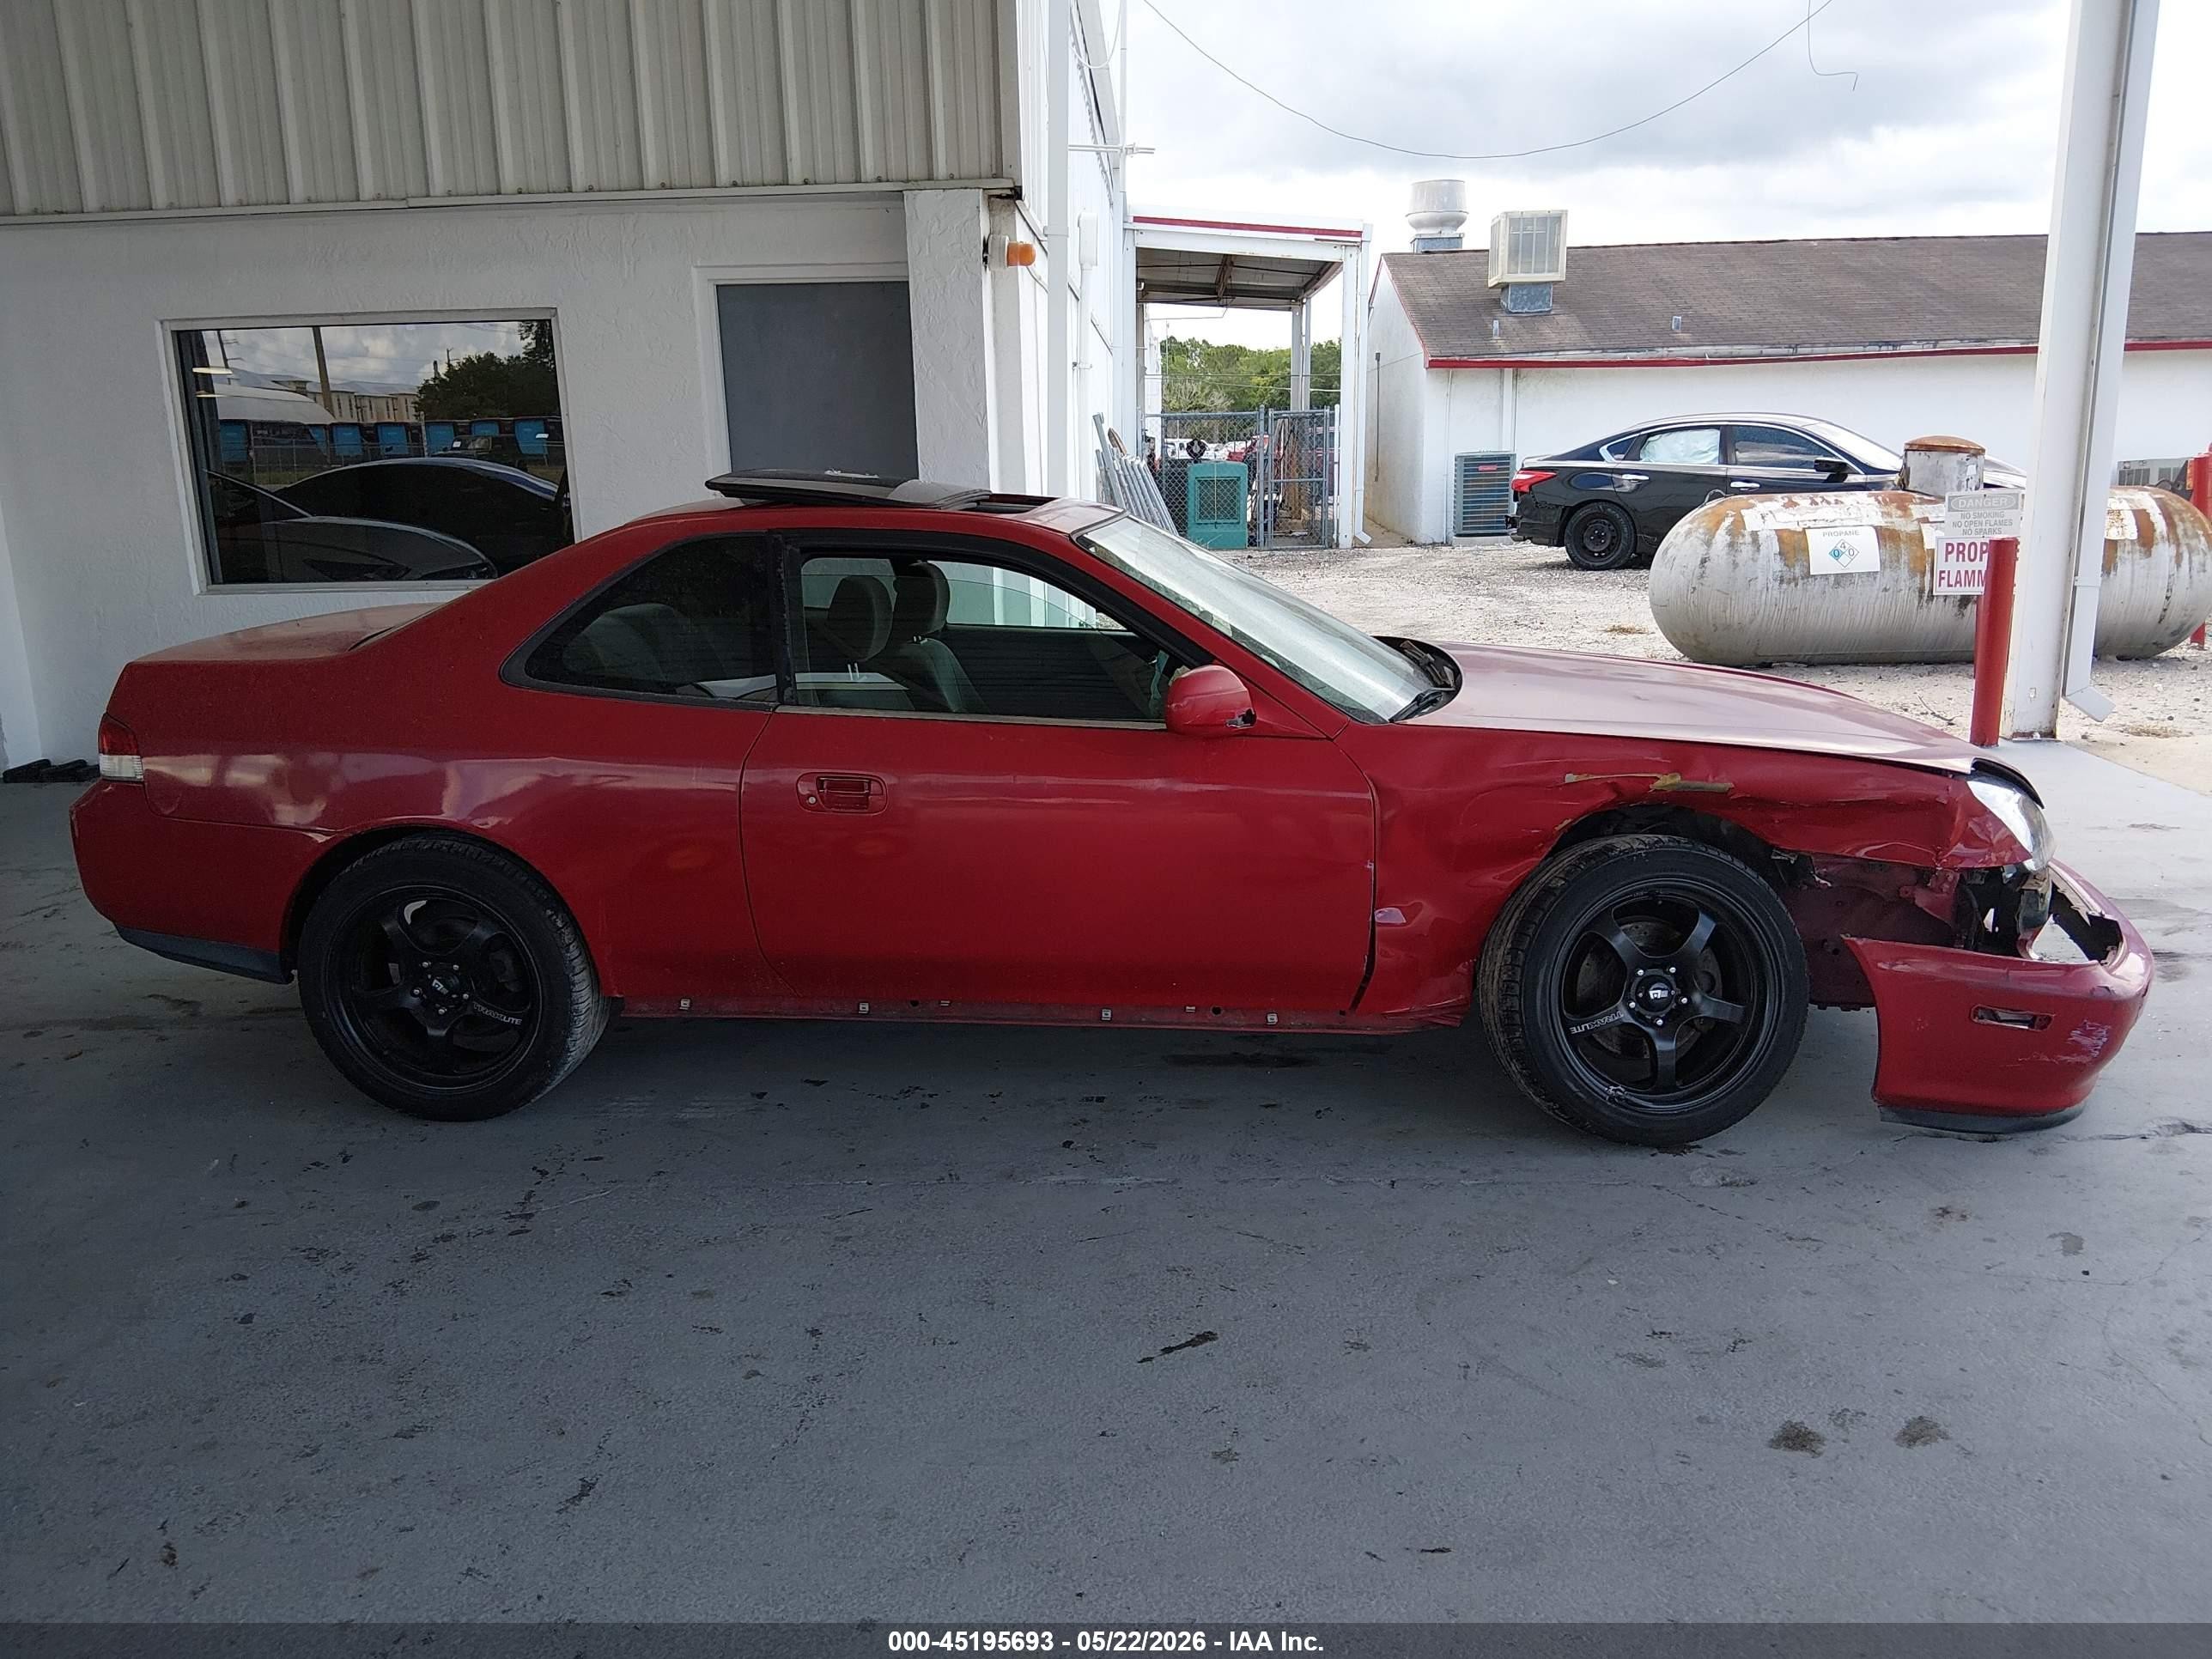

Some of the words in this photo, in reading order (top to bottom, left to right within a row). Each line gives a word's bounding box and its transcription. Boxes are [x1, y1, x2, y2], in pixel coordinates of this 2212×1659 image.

[1958, 497, 2008, 508] DANGER
[1972, 511, 2005, 520] SMOKING
[1952, 520, 1963, 529] NO
[1964, 520, 1984, 528] OPEN
[1984, 519, 2014, 527] FLAMES
[1822, 529, 1861, 538] PROPANE
[1962, 528, 1973, 537] NO
[1974, 527, 2002, 536] SPARKS
[1832, 549, 1840, 558] 0
[1848, 548, 1856, 557] 0
[1944, 541, 1990, 563] PROP
